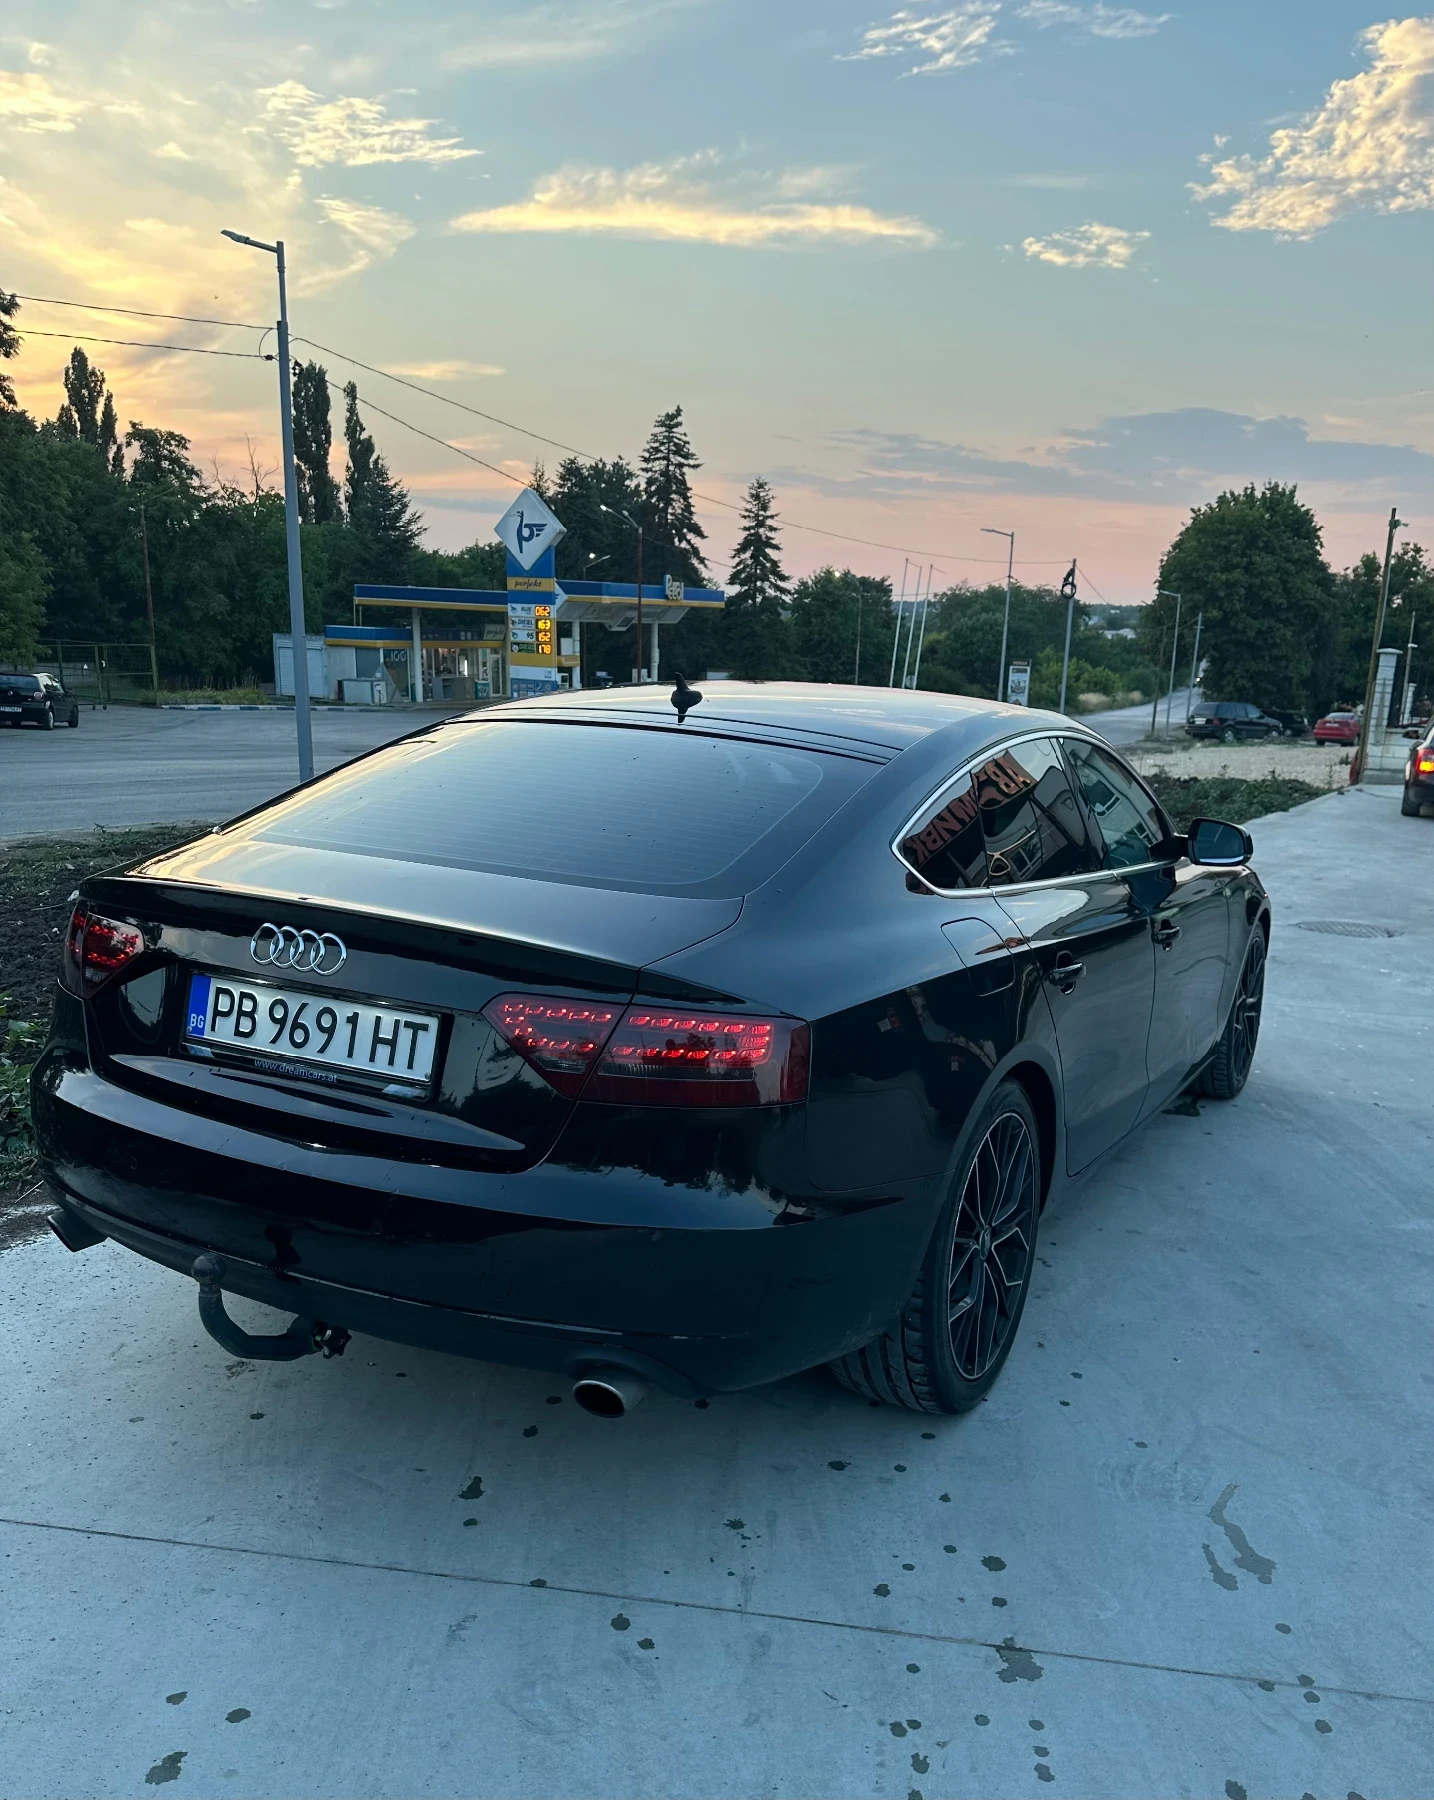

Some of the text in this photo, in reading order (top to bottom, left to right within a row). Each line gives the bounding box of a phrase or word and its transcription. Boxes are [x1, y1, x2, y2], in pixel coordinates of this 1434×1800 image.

[517, 618, 534, 626] DIESEL
[526, 632, 535, 640] 95
[538, 644, 551, 654] 178
[189, 1013, 205, 1029] BG
[210, 985, 430, 1070] PB 9691 HT
[254, 1059, 338, 1083] www.dreamcars.at
